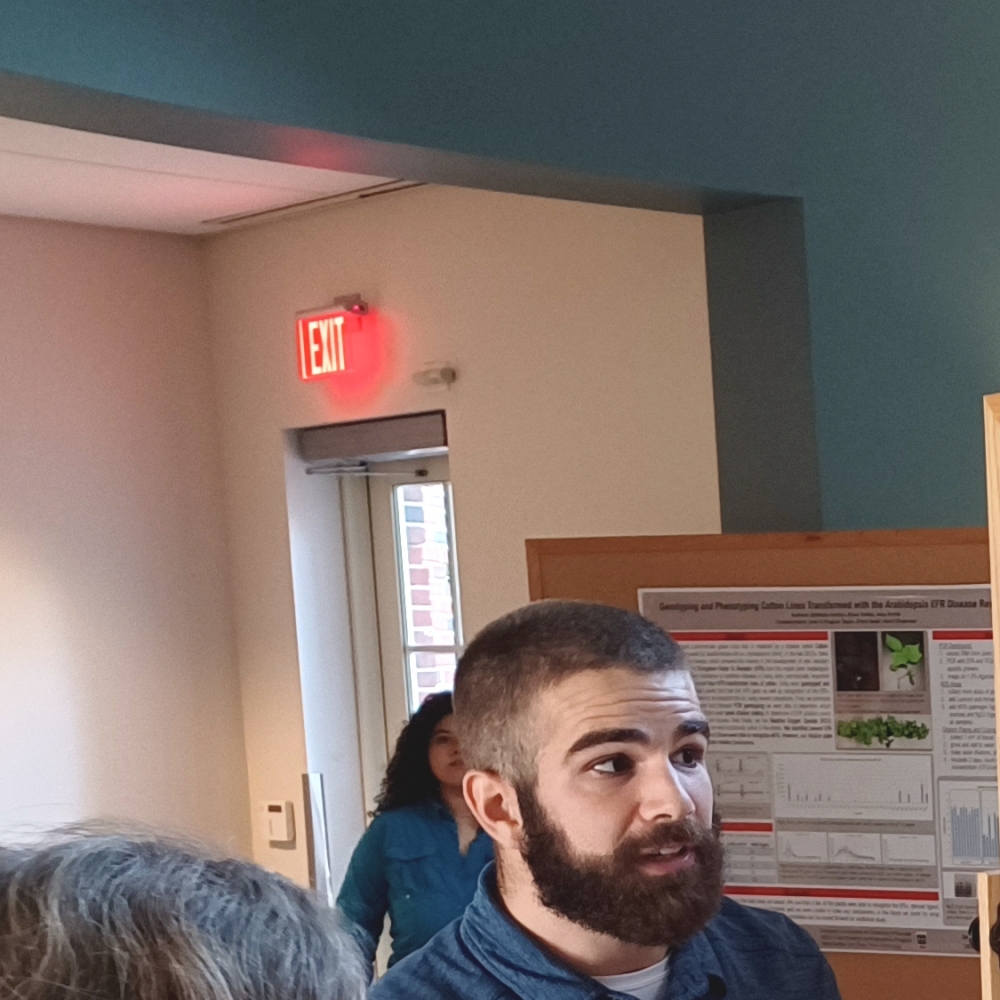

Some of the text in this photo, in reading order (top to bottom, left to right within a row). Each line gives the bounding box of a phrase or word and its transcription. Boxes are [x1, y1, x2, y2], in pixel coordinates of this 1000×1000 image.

[308, 316, 345, 375] EXIT
[885, 600, 928, 610] Arabidopsis
[947, 600, 977, 608] Disease
